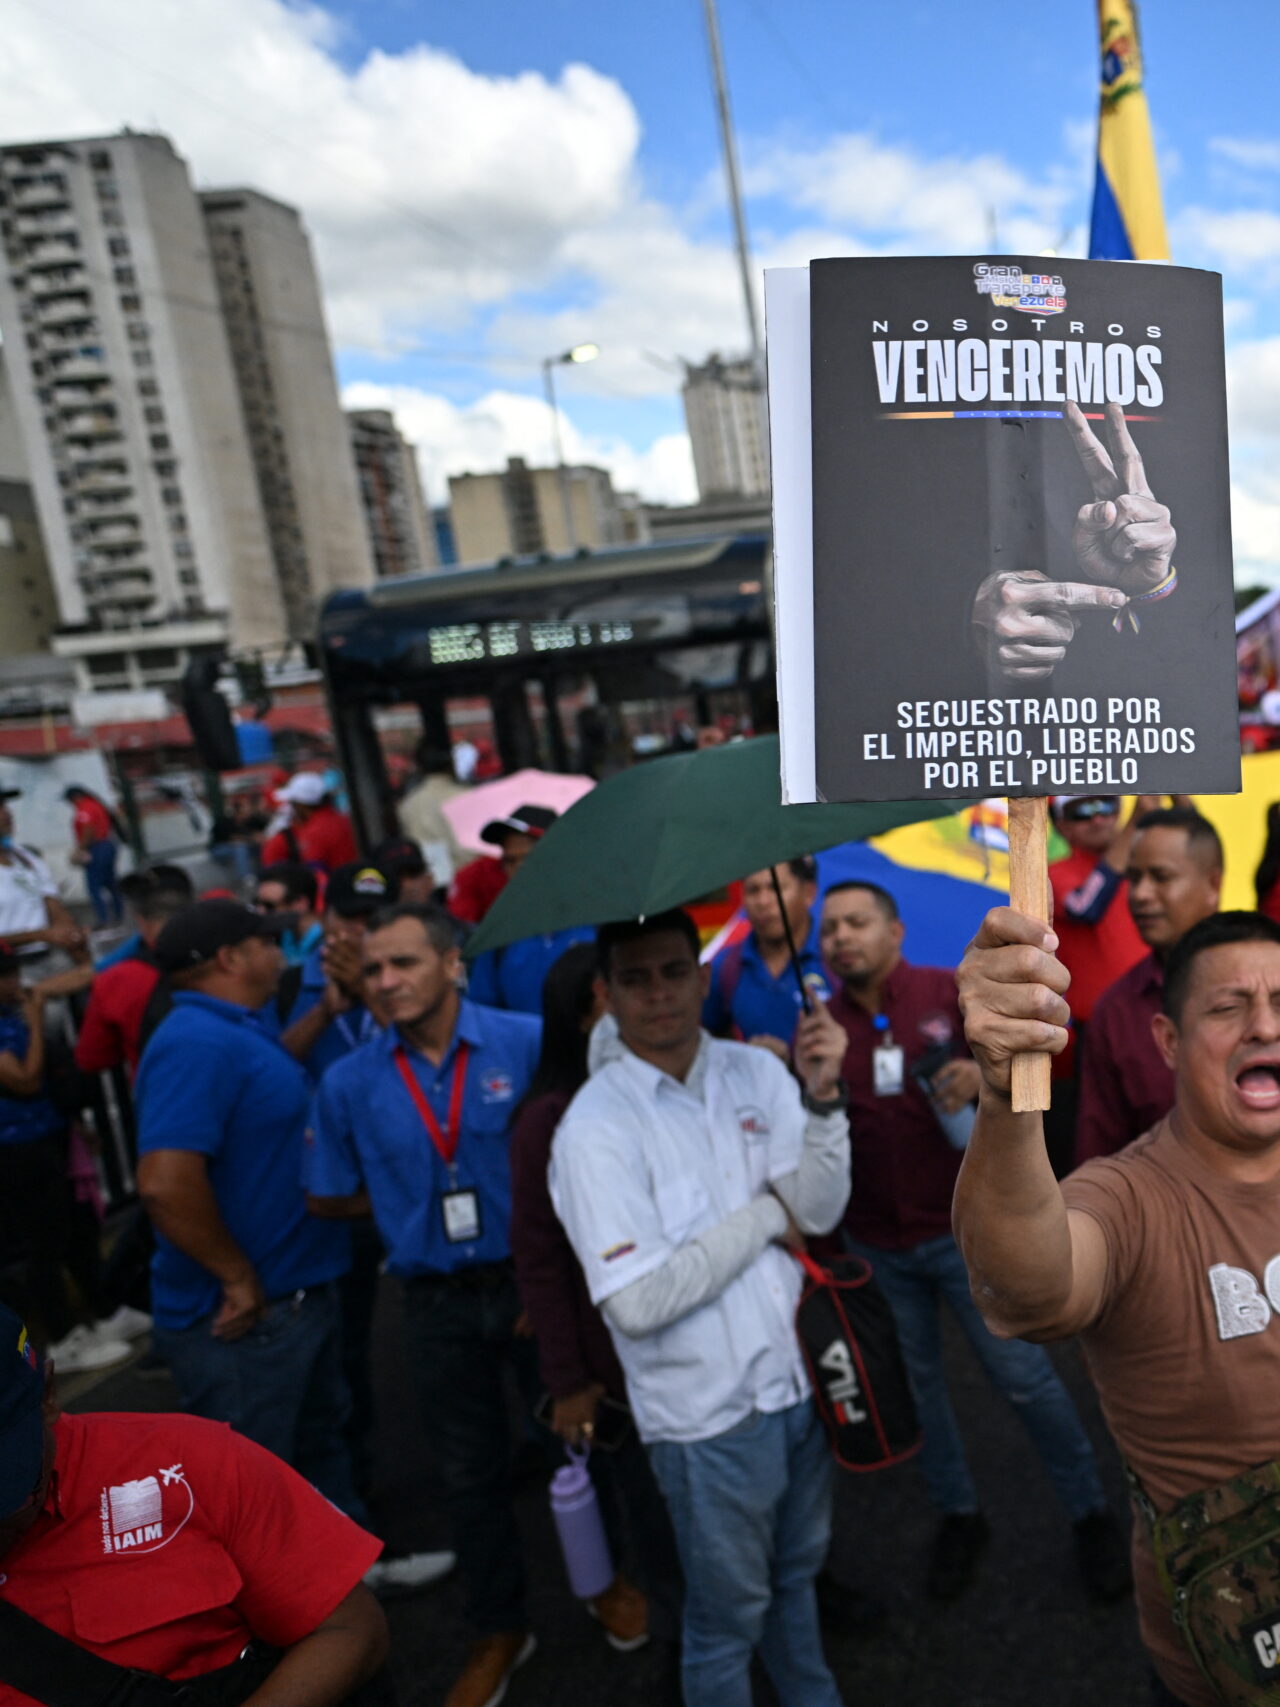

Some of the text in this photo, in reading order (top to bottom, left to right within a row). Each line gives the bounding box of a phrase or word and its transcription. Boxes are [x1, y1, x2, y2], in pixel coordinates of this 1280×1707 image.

[974, 263, 1021, 277] Gran
[975, 280, 1066, 297] Transporte
[992, 294, 1066, 309] Venezuela
[872, 319, 1162, 338] NOSOTROS
[872, 338, 1164, 408] VENCEREMOS
[897, 697, 1161, 728] SECUESTRADO POR
[863, 727, 1195, 760] EL IMPERIO, LIBERADOS
[924, 757, 1138, 789] POR EL PUEBLO
[819, 1339, 867, 1424] FILA
[113, 1523, 163, 1551] IAIM
